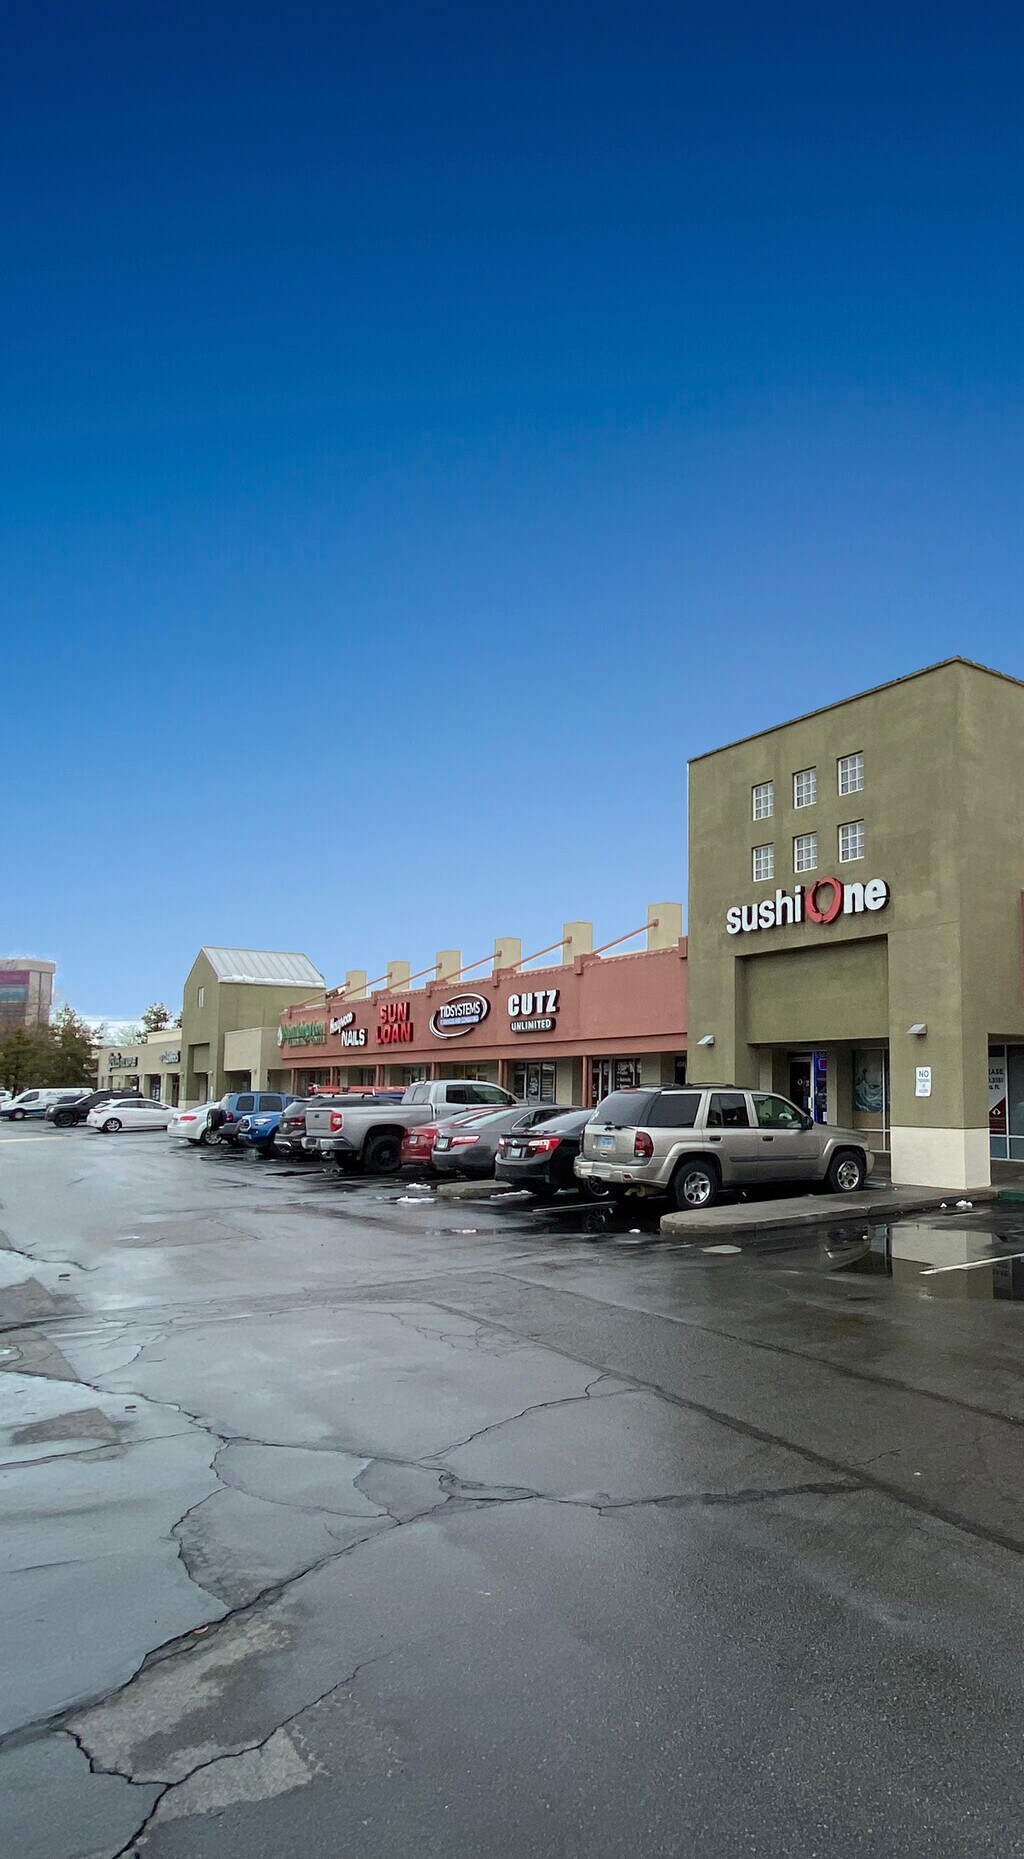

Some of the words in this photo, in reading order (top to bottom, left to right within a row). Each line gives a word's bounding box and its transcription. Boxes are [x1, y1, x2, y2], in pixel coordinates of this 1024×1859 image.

[726, 884, 802, 935] sushi
[805, 875, 888, 924] One
[380, 1001, 409, 1025] SUN
[507, 989, 558, 1017] CUTZ
[375, 1022, 413, 1045] LOAN
[511, 1018, 552, 1031] UNLIMITED
[341, 1028, 366, 1047] NAILS
[918, 1069, 930, 1078] NO
